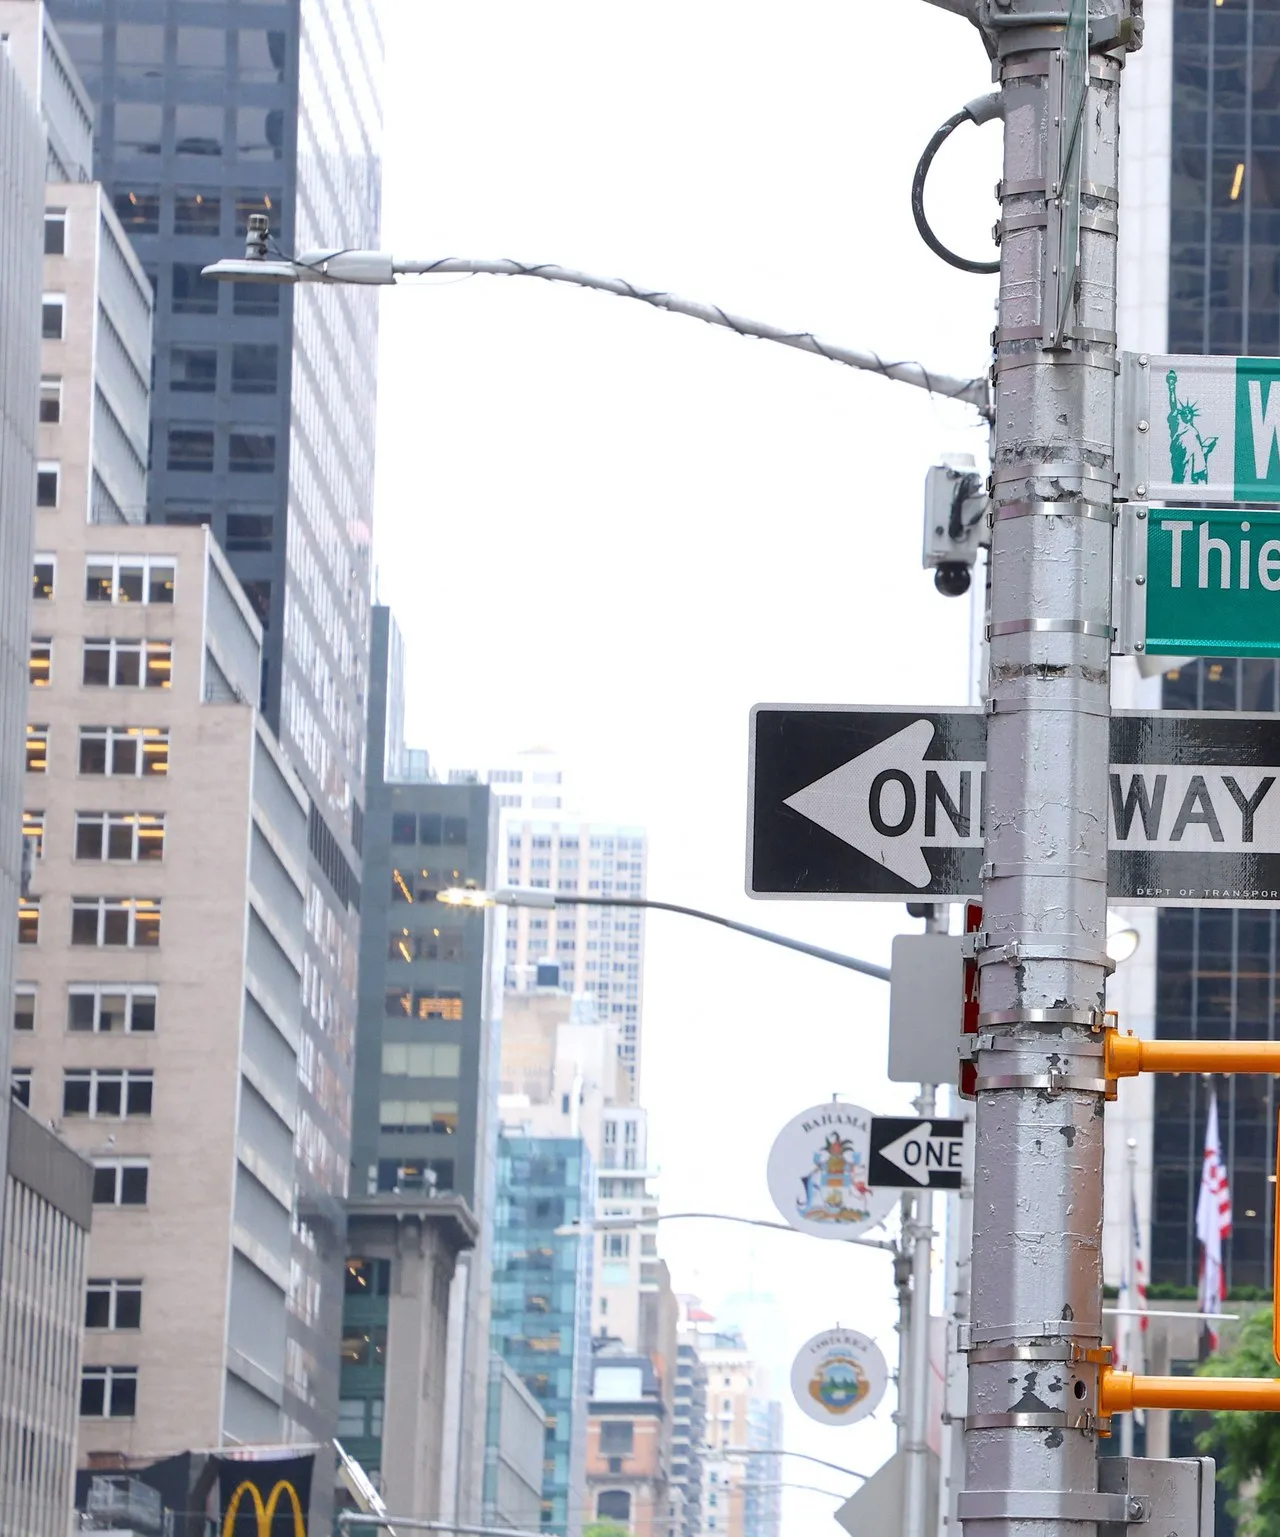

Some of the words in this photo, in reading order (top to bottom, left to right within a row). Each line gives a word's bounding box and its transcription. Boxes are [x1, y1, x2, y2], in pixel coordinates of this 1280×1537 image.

[1109, 773, 1277, 843] WAY
[1136, 888, 1171, 896] DEPT
[802, 1113, 868, 1134] BAHAMA
[904, 1140, 963, 1168] ONE
